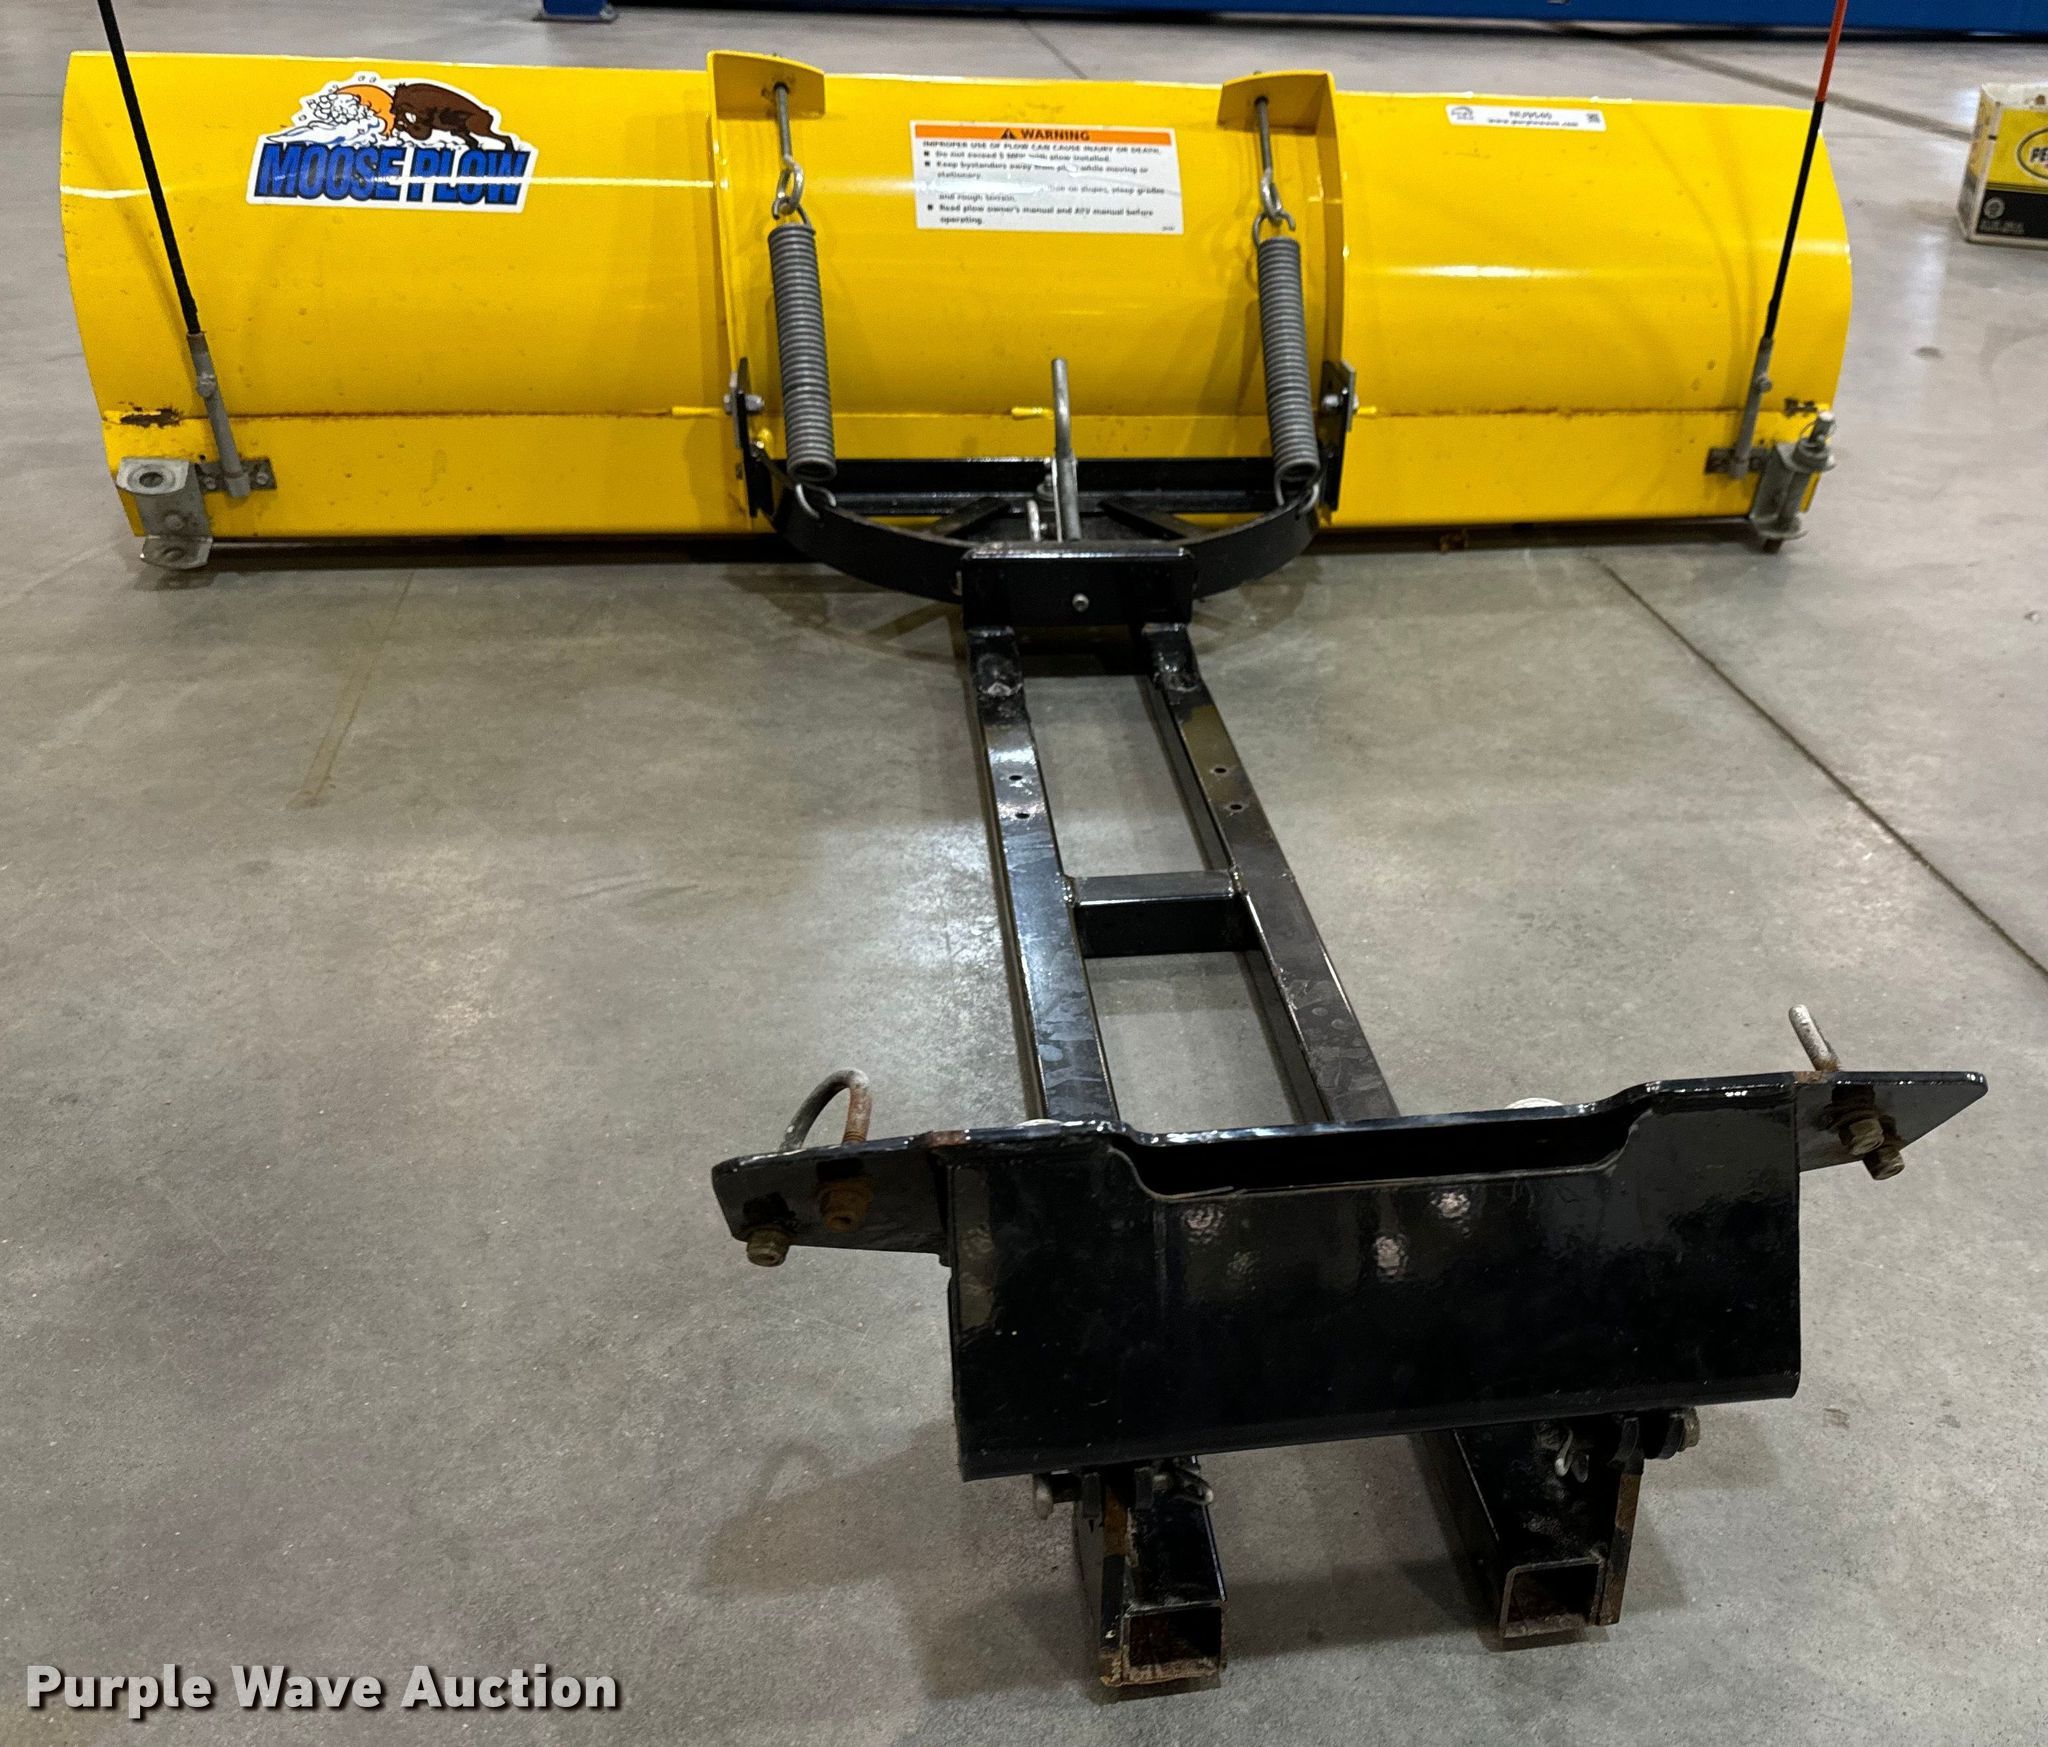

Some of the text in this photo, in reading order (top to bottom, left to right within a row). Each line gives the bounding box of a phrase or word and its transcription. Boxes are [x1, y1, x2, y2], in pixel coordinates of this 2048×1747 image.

[1020, 128, 1090, 141] WARNING
[922, 140, 968, 148] IMPROPER
[970, 141, 987, 149] USE
[1030, 143, 1051, 151] CAN
[1052, 144, 1080, 152] CAUSE
[1083, 145, 1114, 153] INJURY
[935, 150, 948, 158] Do
[949, 150, 966, 158] not
[967, 151, 998, 159] exceed
[254, 143, 531, 205] MOOSE PLOW
[936, 161, 959, 169] Keep
[960, 161, 1008, 170] bystanders
[1106, 165, 1138, 174] moving
[939, 203, 961, 212] Read
[962, 204, 985, 214] plow
[1022, 206, 1055, 214] manual
[1055, 207, 1073, 215] and
[1092, 207, 1124, 216] manual
[1125, 208, 1154, 217] before
